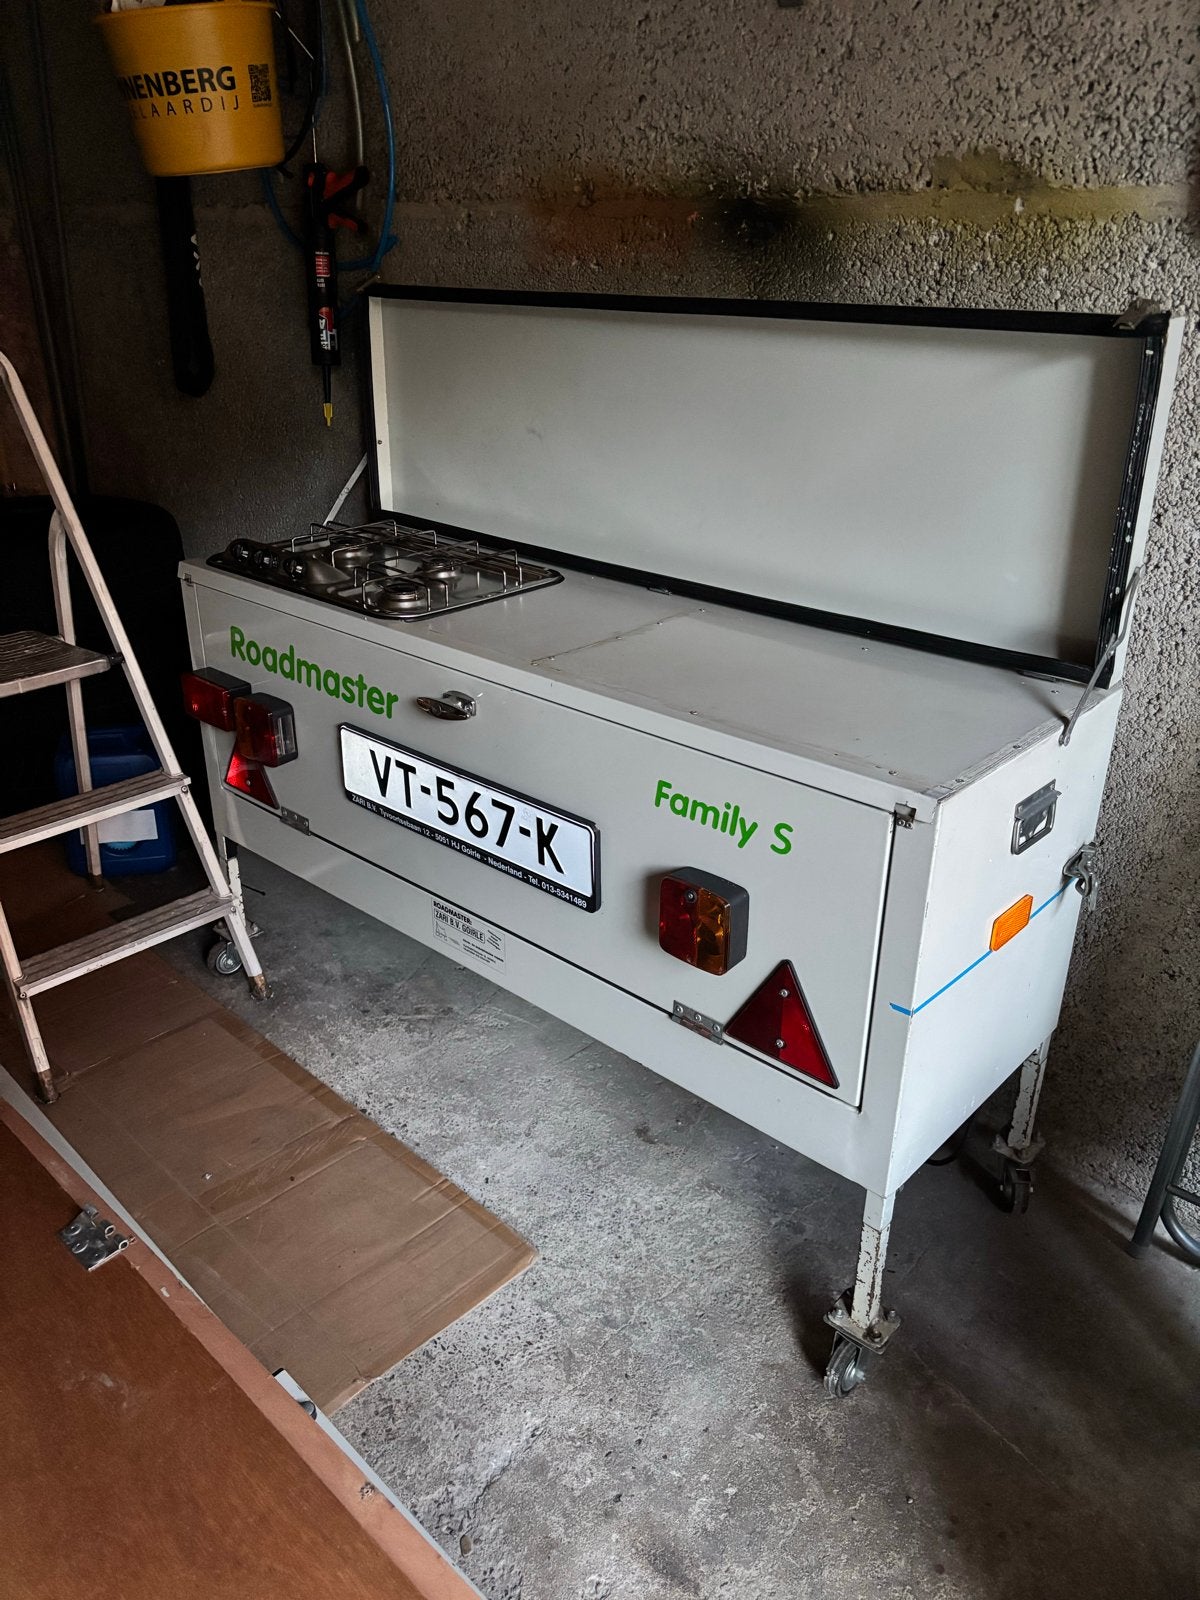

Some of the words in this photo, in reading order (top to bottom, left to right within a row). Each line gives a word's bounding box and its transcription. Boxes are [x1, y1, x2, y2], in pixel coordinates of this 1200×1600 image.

[230, 625, 399, 720] Roadmaster
[351, 794, 366, 809] ZARI
[422, 827, 430, 837] 12
[450, 840, 460, 850] HJ
[461, 844, 481, 860] Goirle
[487, 856, 523, 879] Nederland
[527, 874, 541, 887] Tel.
[541, 881, 587, 909] 013-5341489
[369, 748, 565, 875] VT-567-K
[654, 779, 759, 849] Family
[770, 822, 794, 855] S
[435, 911, 449, 924] ZARI
[461, 924, 484, 942] GOIRLE
